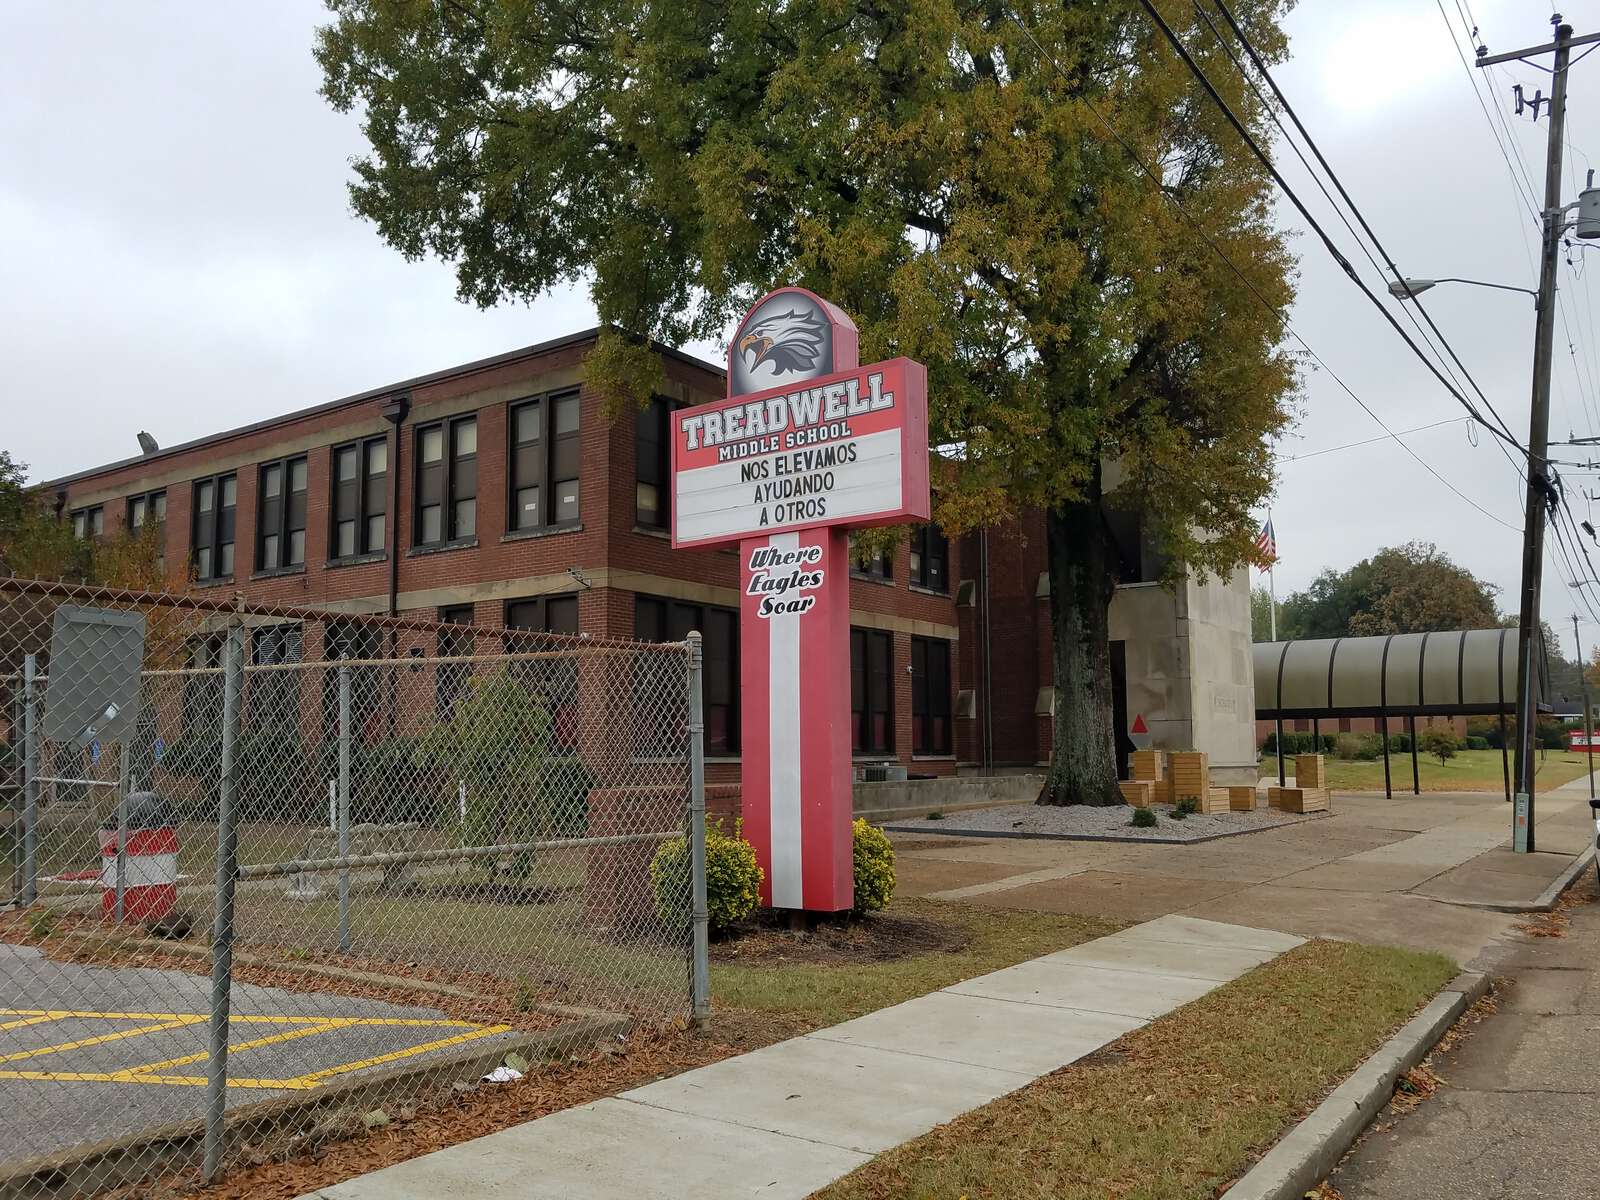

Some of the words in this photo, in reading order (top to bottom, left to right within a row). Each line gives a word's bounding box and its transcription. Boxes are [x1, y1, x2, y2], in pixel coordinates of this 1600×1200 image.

[681, 372, 894, 451] TREADWELL
[719, 436, 780, 462] MIDDLE
[785, 421, 851, 448] SCHOOL
[741, 460, 769, 483] NOS
[775, 442, 857, 477] ELEVAMOS
[754, 471, 834, 504] AYUDANDO
[759, 507, 769, 526] A
[775, 497, 826, 523] OTROS
[750, 546, 820, 569] Where
[748, 570, 822, 595] Eagles
[759, 597, 814, 616] Soar
